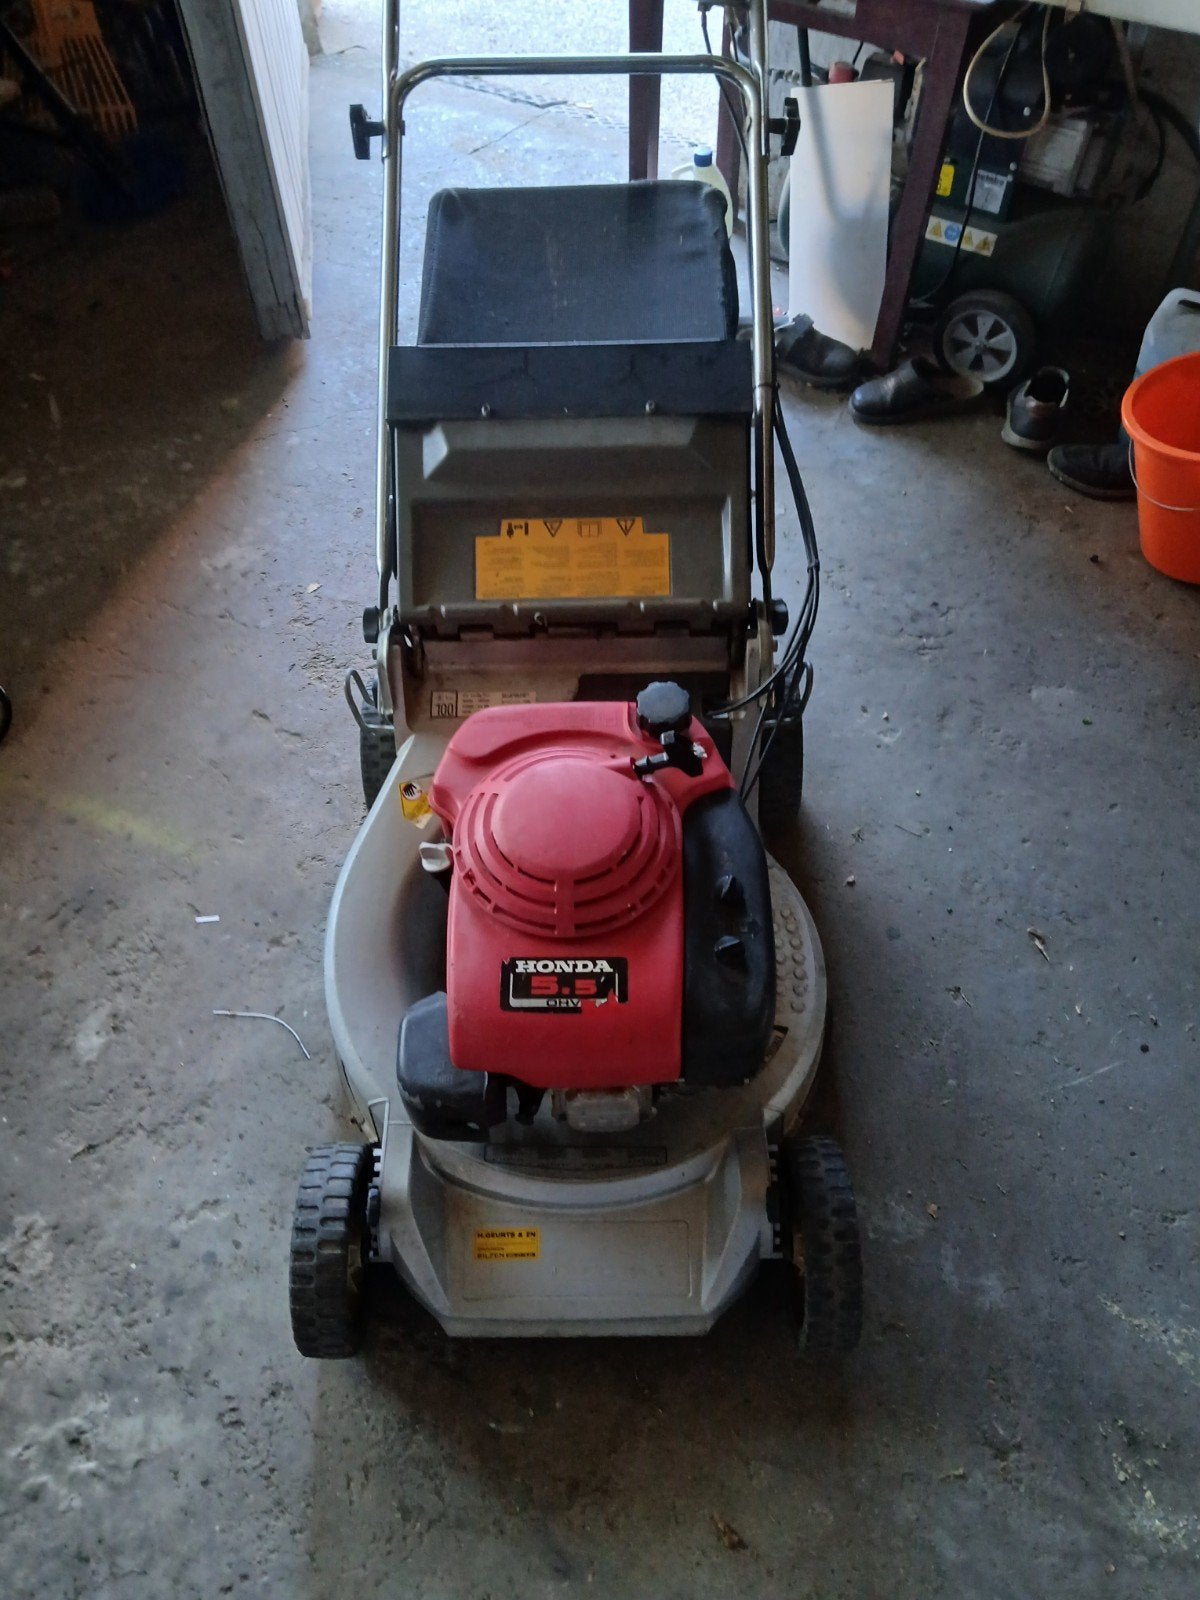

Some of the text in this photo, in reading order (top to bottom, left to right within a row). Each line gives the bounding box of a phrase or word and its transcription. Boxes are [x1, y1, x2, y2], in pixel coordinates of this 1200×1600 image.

[436, 703, 454, 716] 100
[515, 959, 614, 973] HONDA
[530, 975, 598, 996] 5.5
